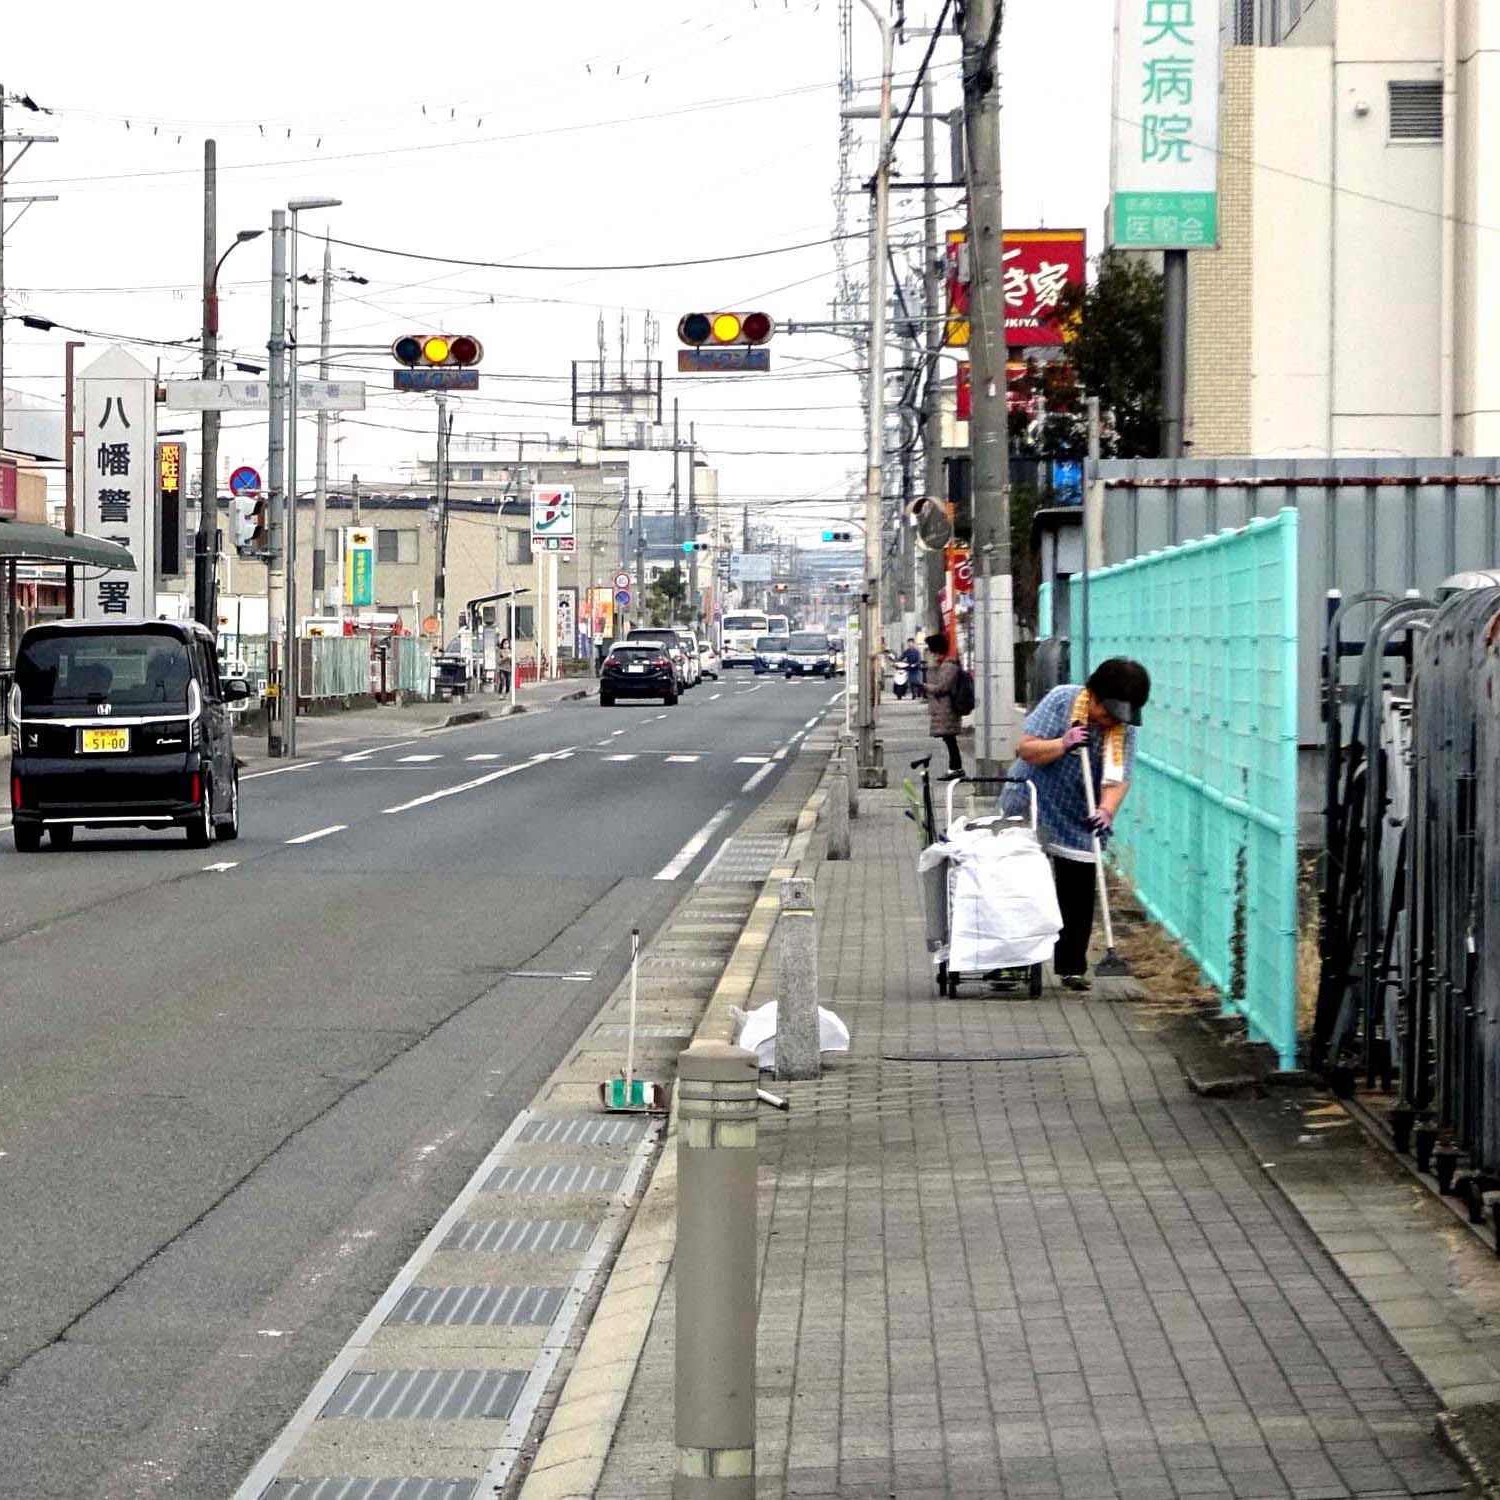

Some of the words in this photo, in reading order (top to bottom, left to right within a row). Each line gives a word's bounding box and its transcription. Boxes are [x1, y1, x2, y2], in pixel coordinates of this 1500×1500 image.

[1141, 0, 1195, 163] 央病院
[92, 738, 126, 750] 51-00
